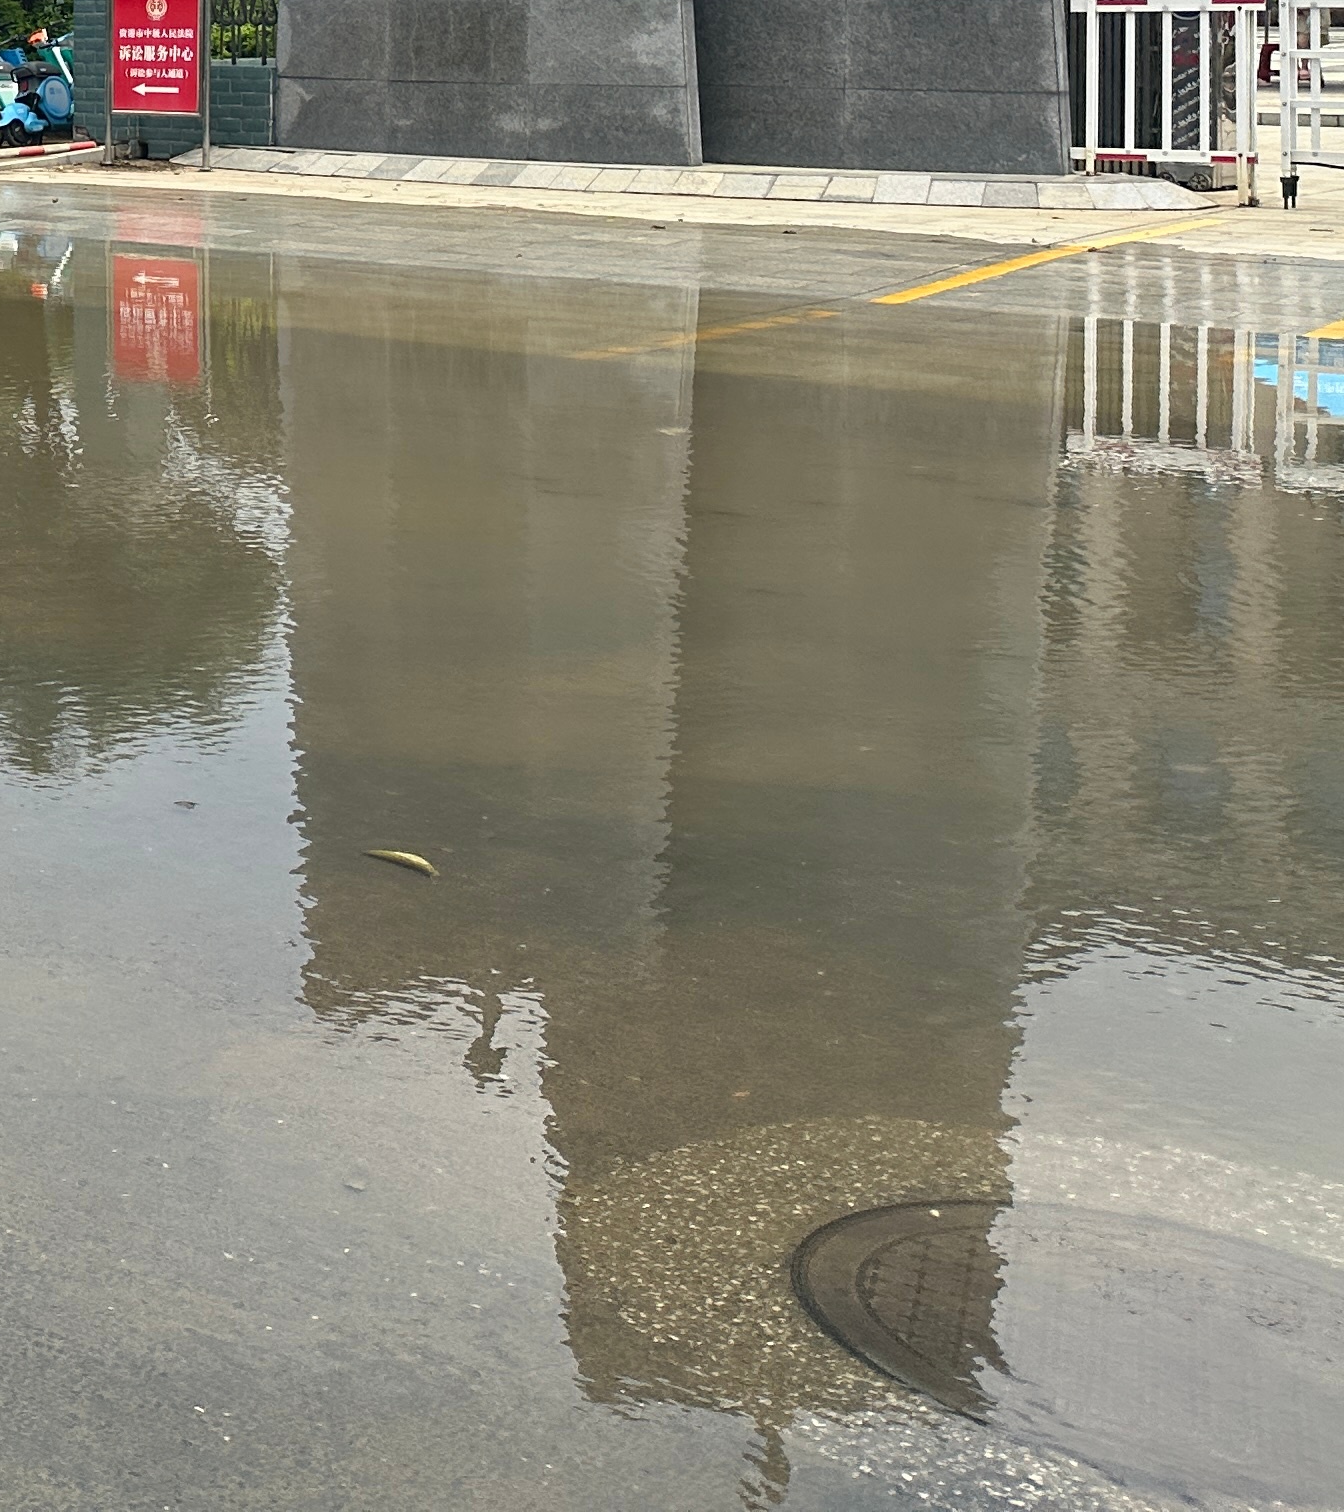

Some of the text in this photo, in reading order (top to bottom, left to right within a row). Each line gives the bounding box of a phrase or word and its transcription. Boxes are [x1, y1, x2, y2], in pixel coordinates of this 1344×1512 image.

[119, 45, 194, 62] 诉讼服务中心
